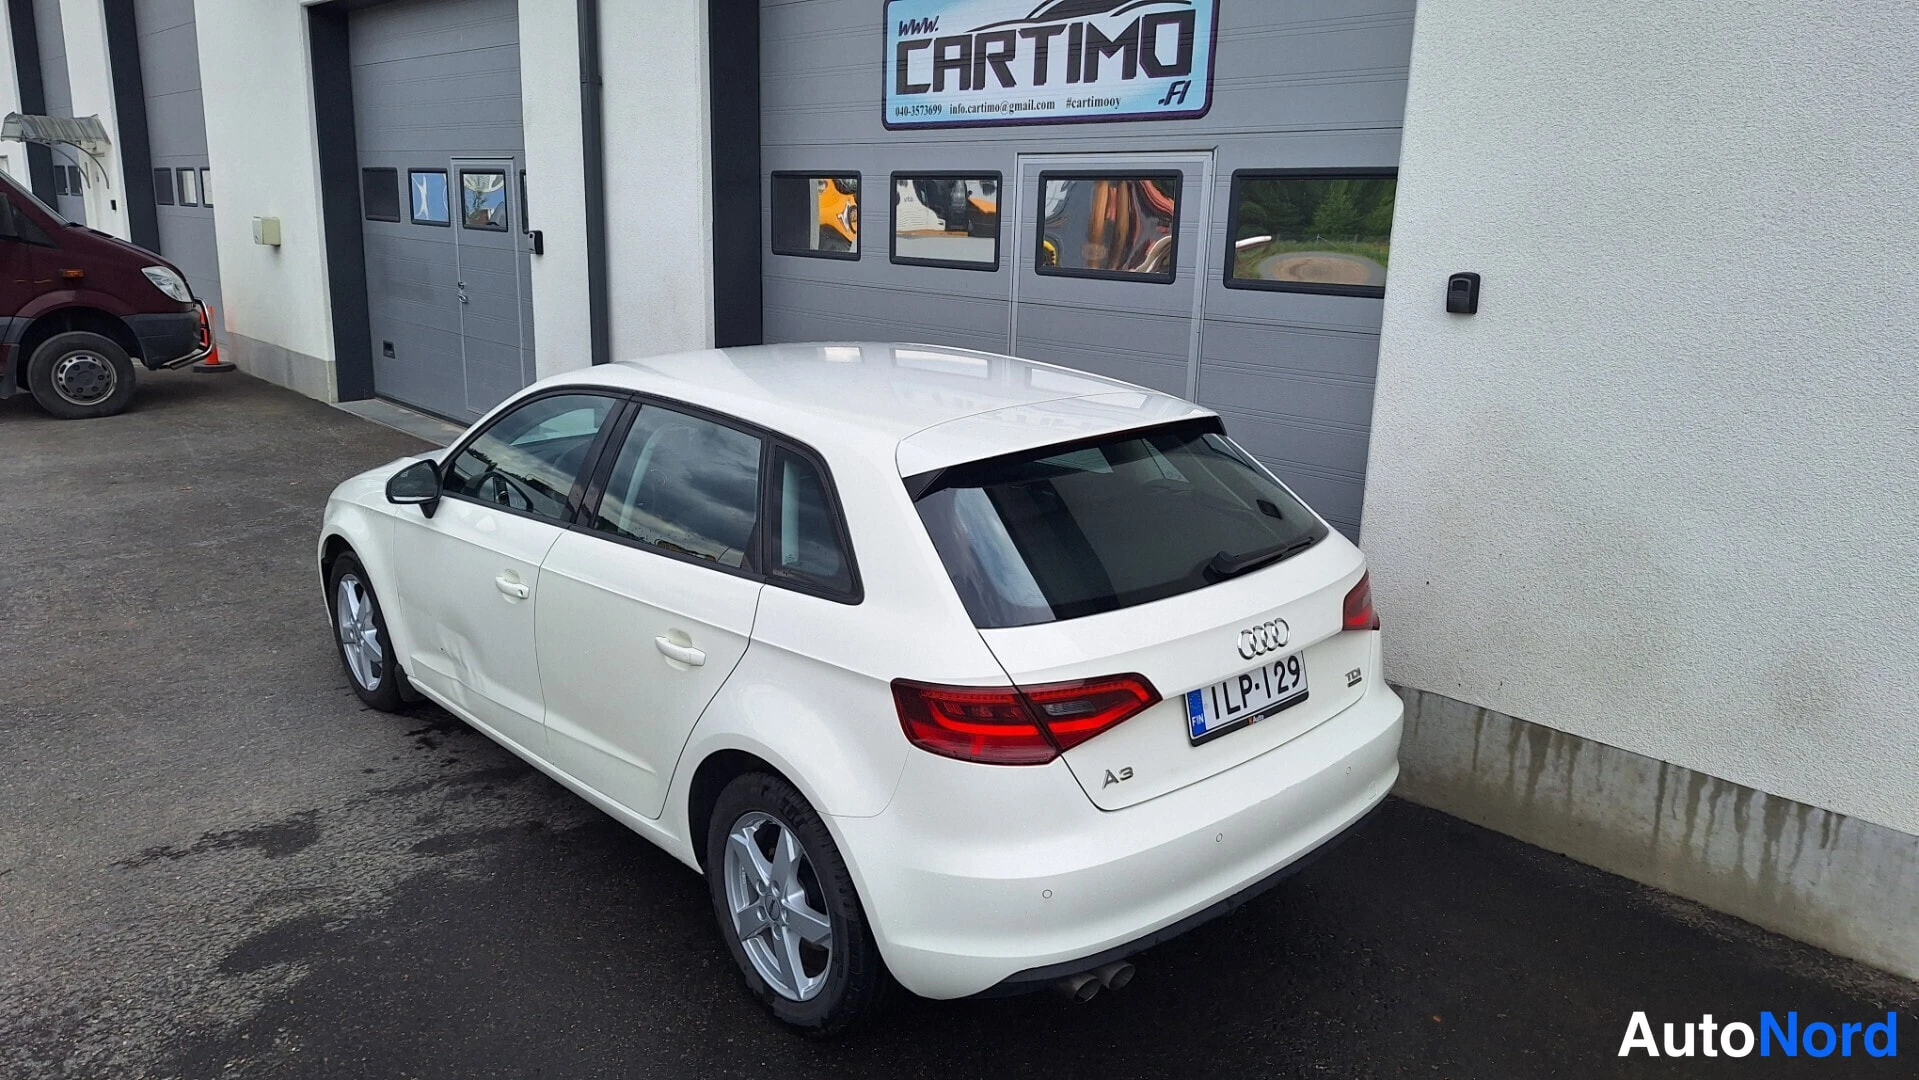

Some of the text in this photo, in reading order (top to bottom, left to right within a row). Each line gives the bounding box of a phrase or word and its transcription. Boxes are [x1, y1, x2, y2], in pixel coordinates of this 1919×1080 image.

[896, 9, 1196, 95] CARTIMO
[895, 96, 1121, 117] 040-3573699 info.cartimo@gmail.com #cartimooy
[1345, 667, 1361, 681] TDI
[1211, 655, 1300, 720] ILP-129
[1192, 713, 1204, 727] FIN
[1102, 766, 1134, 790] A3
